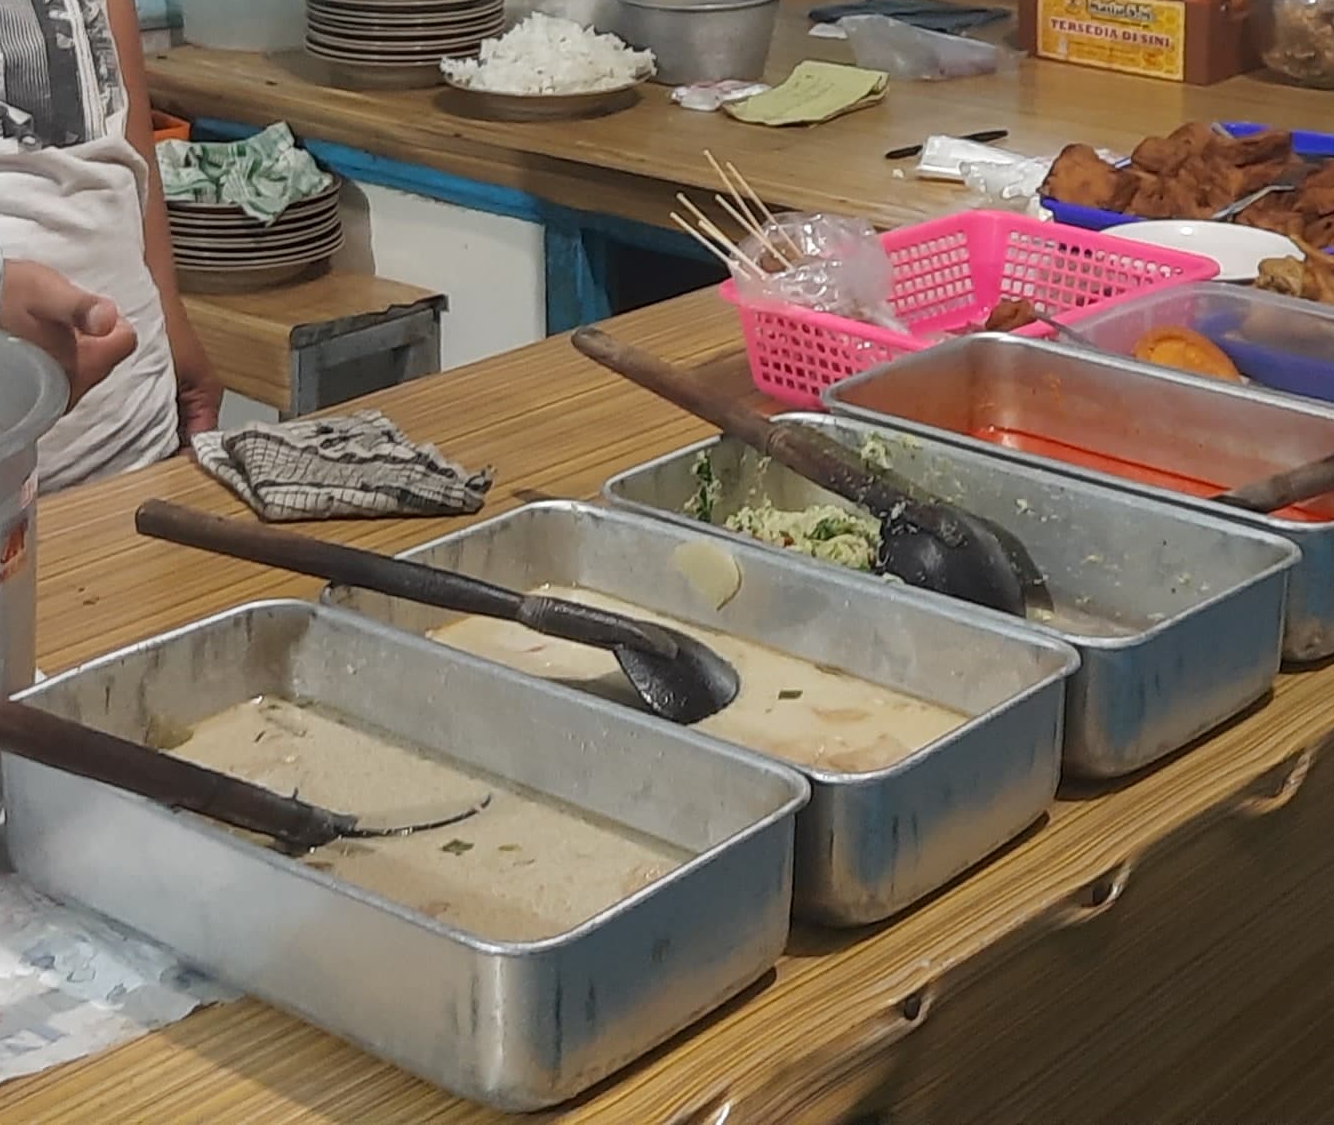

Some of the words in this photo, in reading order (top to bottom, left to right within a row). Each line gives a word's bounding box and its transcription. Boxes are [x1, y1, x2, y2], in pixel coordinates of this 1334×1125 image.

[1050, 18, 1119, 39] TERSEDIA
[1122, 30, 1138, 42] DI
[1141, 32, 1172, 48] SINI
